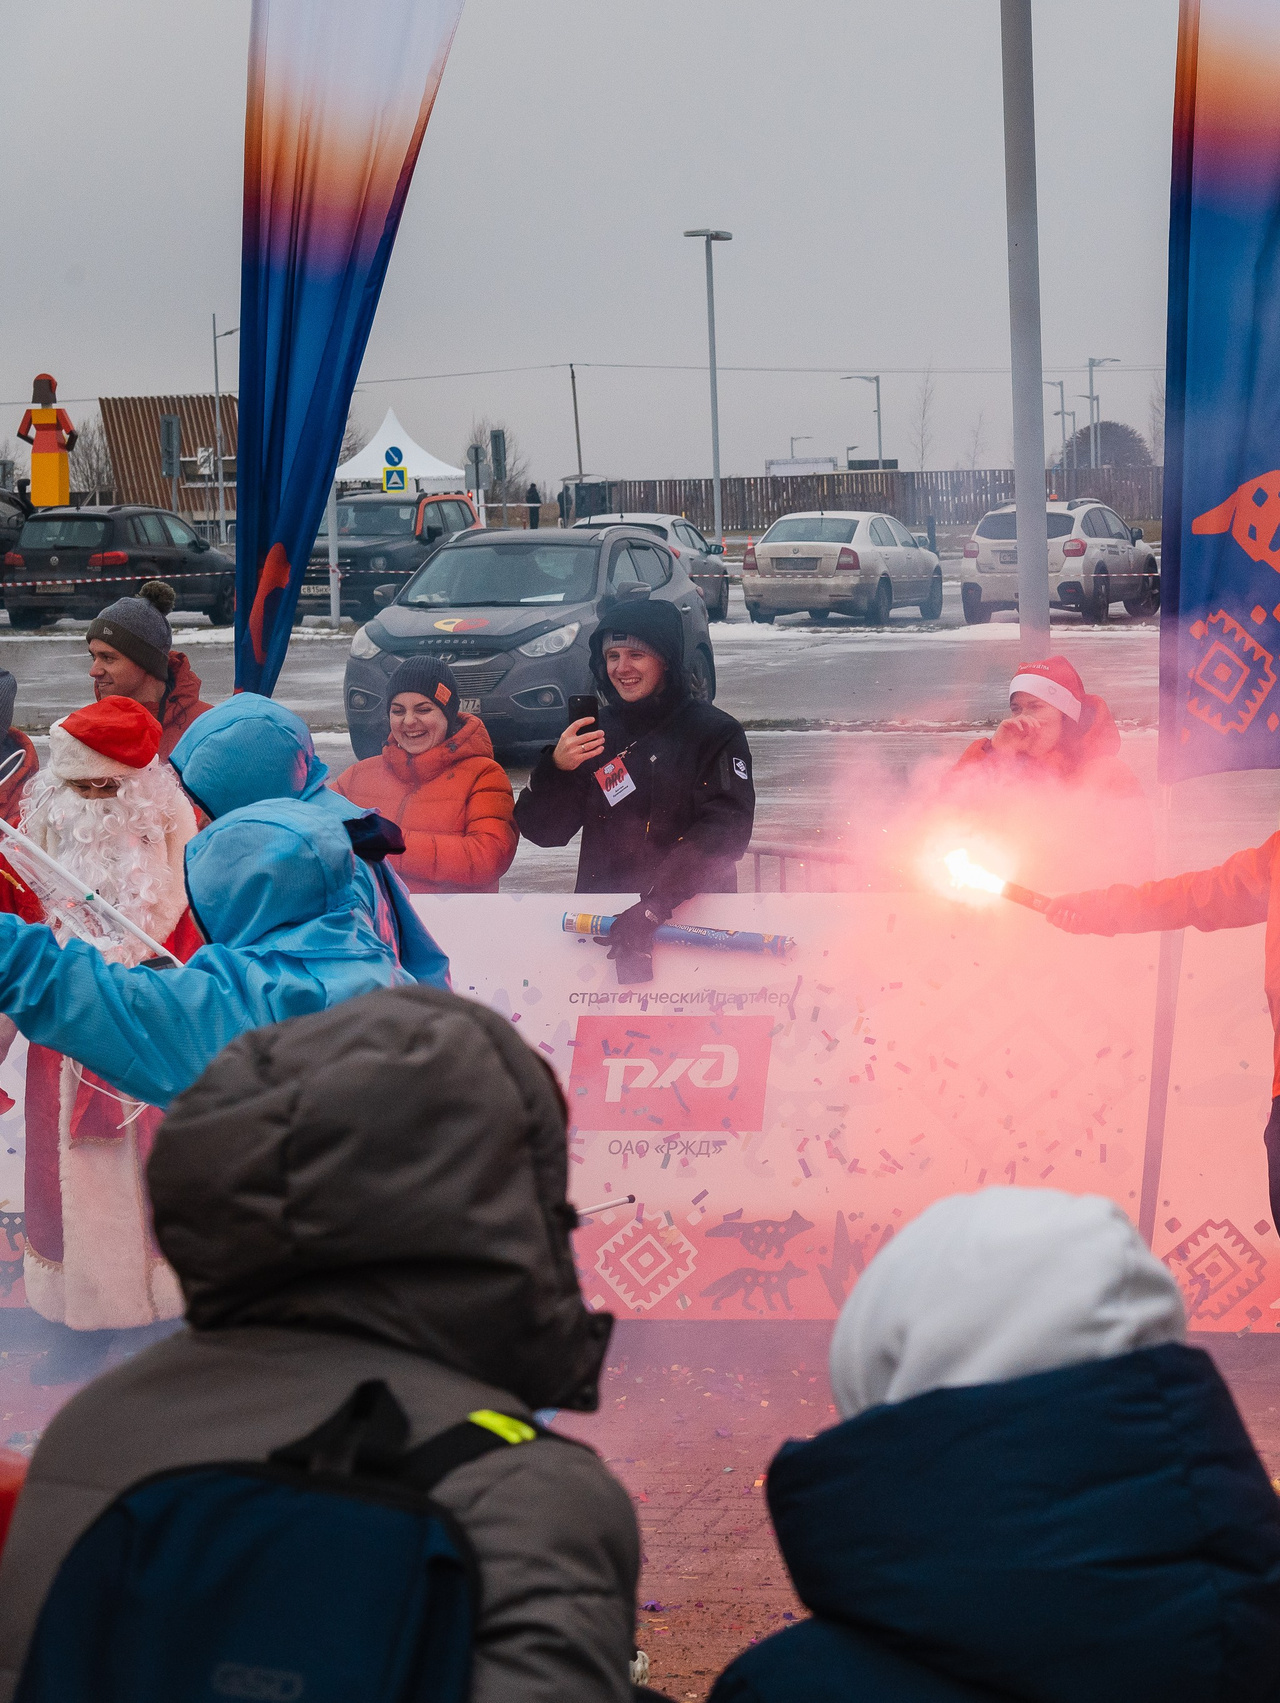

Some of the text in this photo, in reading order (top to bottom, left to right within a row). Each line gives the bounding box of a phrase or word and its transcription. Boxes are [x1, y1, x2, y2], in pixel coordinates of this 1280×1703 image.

[569, 989, 791, 1007] стратегический партнер
[608, 1140, 723, 1157] ОАО «РЖД»
